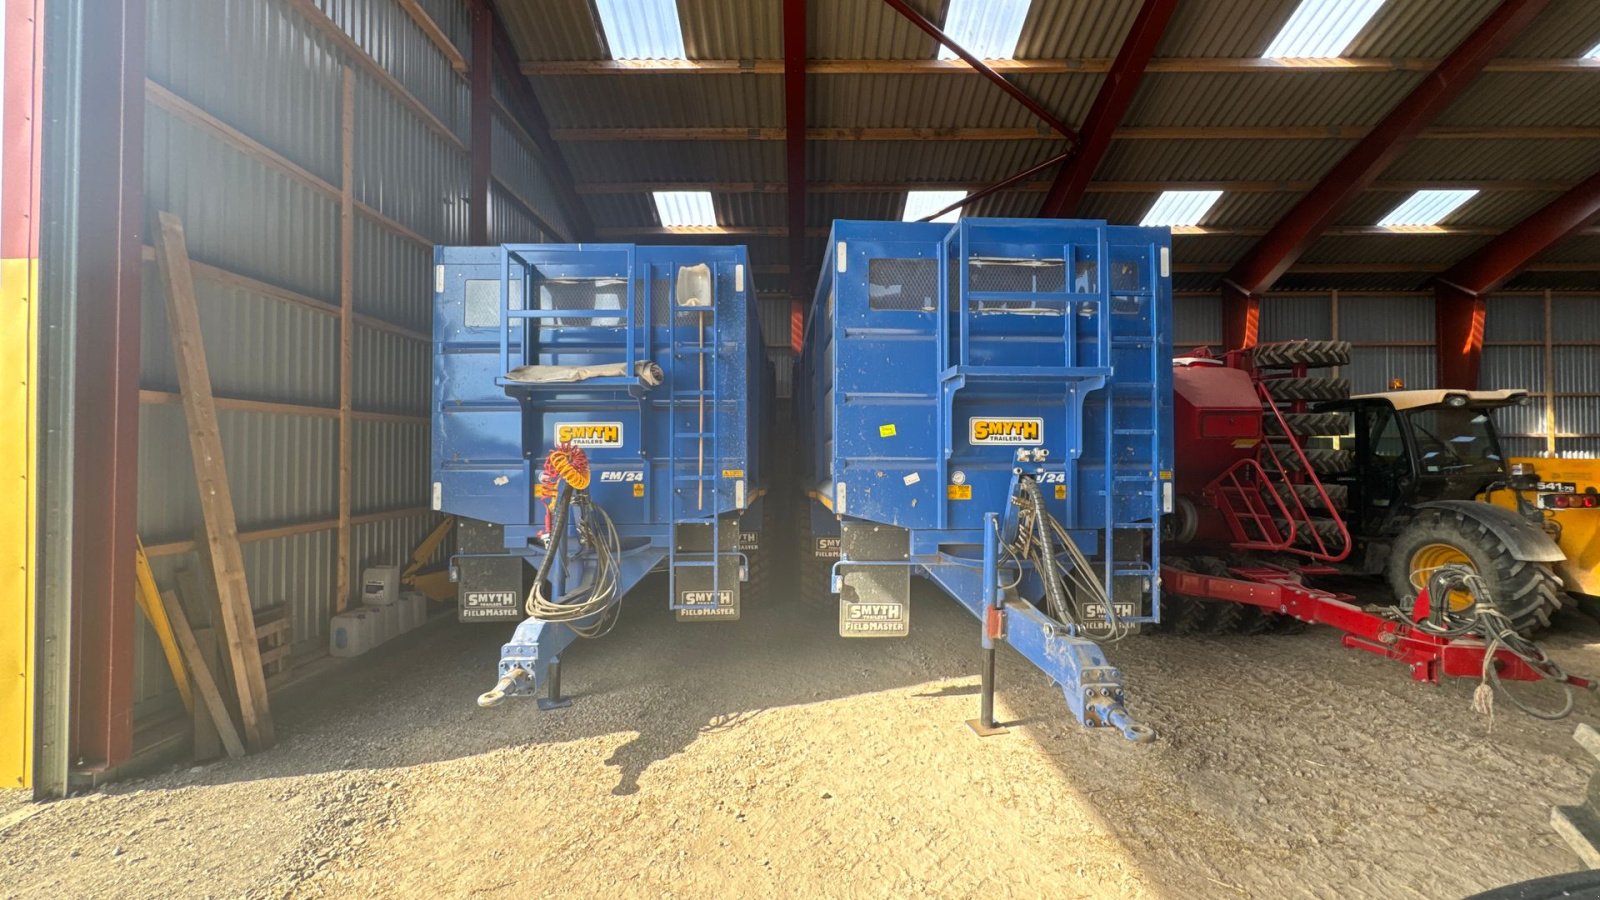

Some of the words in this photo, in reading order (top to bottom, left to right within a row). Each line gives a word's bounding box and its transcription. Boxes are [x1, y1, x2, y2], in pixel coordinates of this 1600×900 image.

[559, 426, 619, 443] SMYTH
[974, 421, 1039, 440] SMYTH
[600, 471, 644, 482] FM/24
[819, 539, 841, 549] SMY
[468, 593, 513, 606] SMYTH
[685, 592, 730, 605] SMYH
[850, 605, 899, 619] SMYTH
[1086, 604, 1132, 618] SMTH
